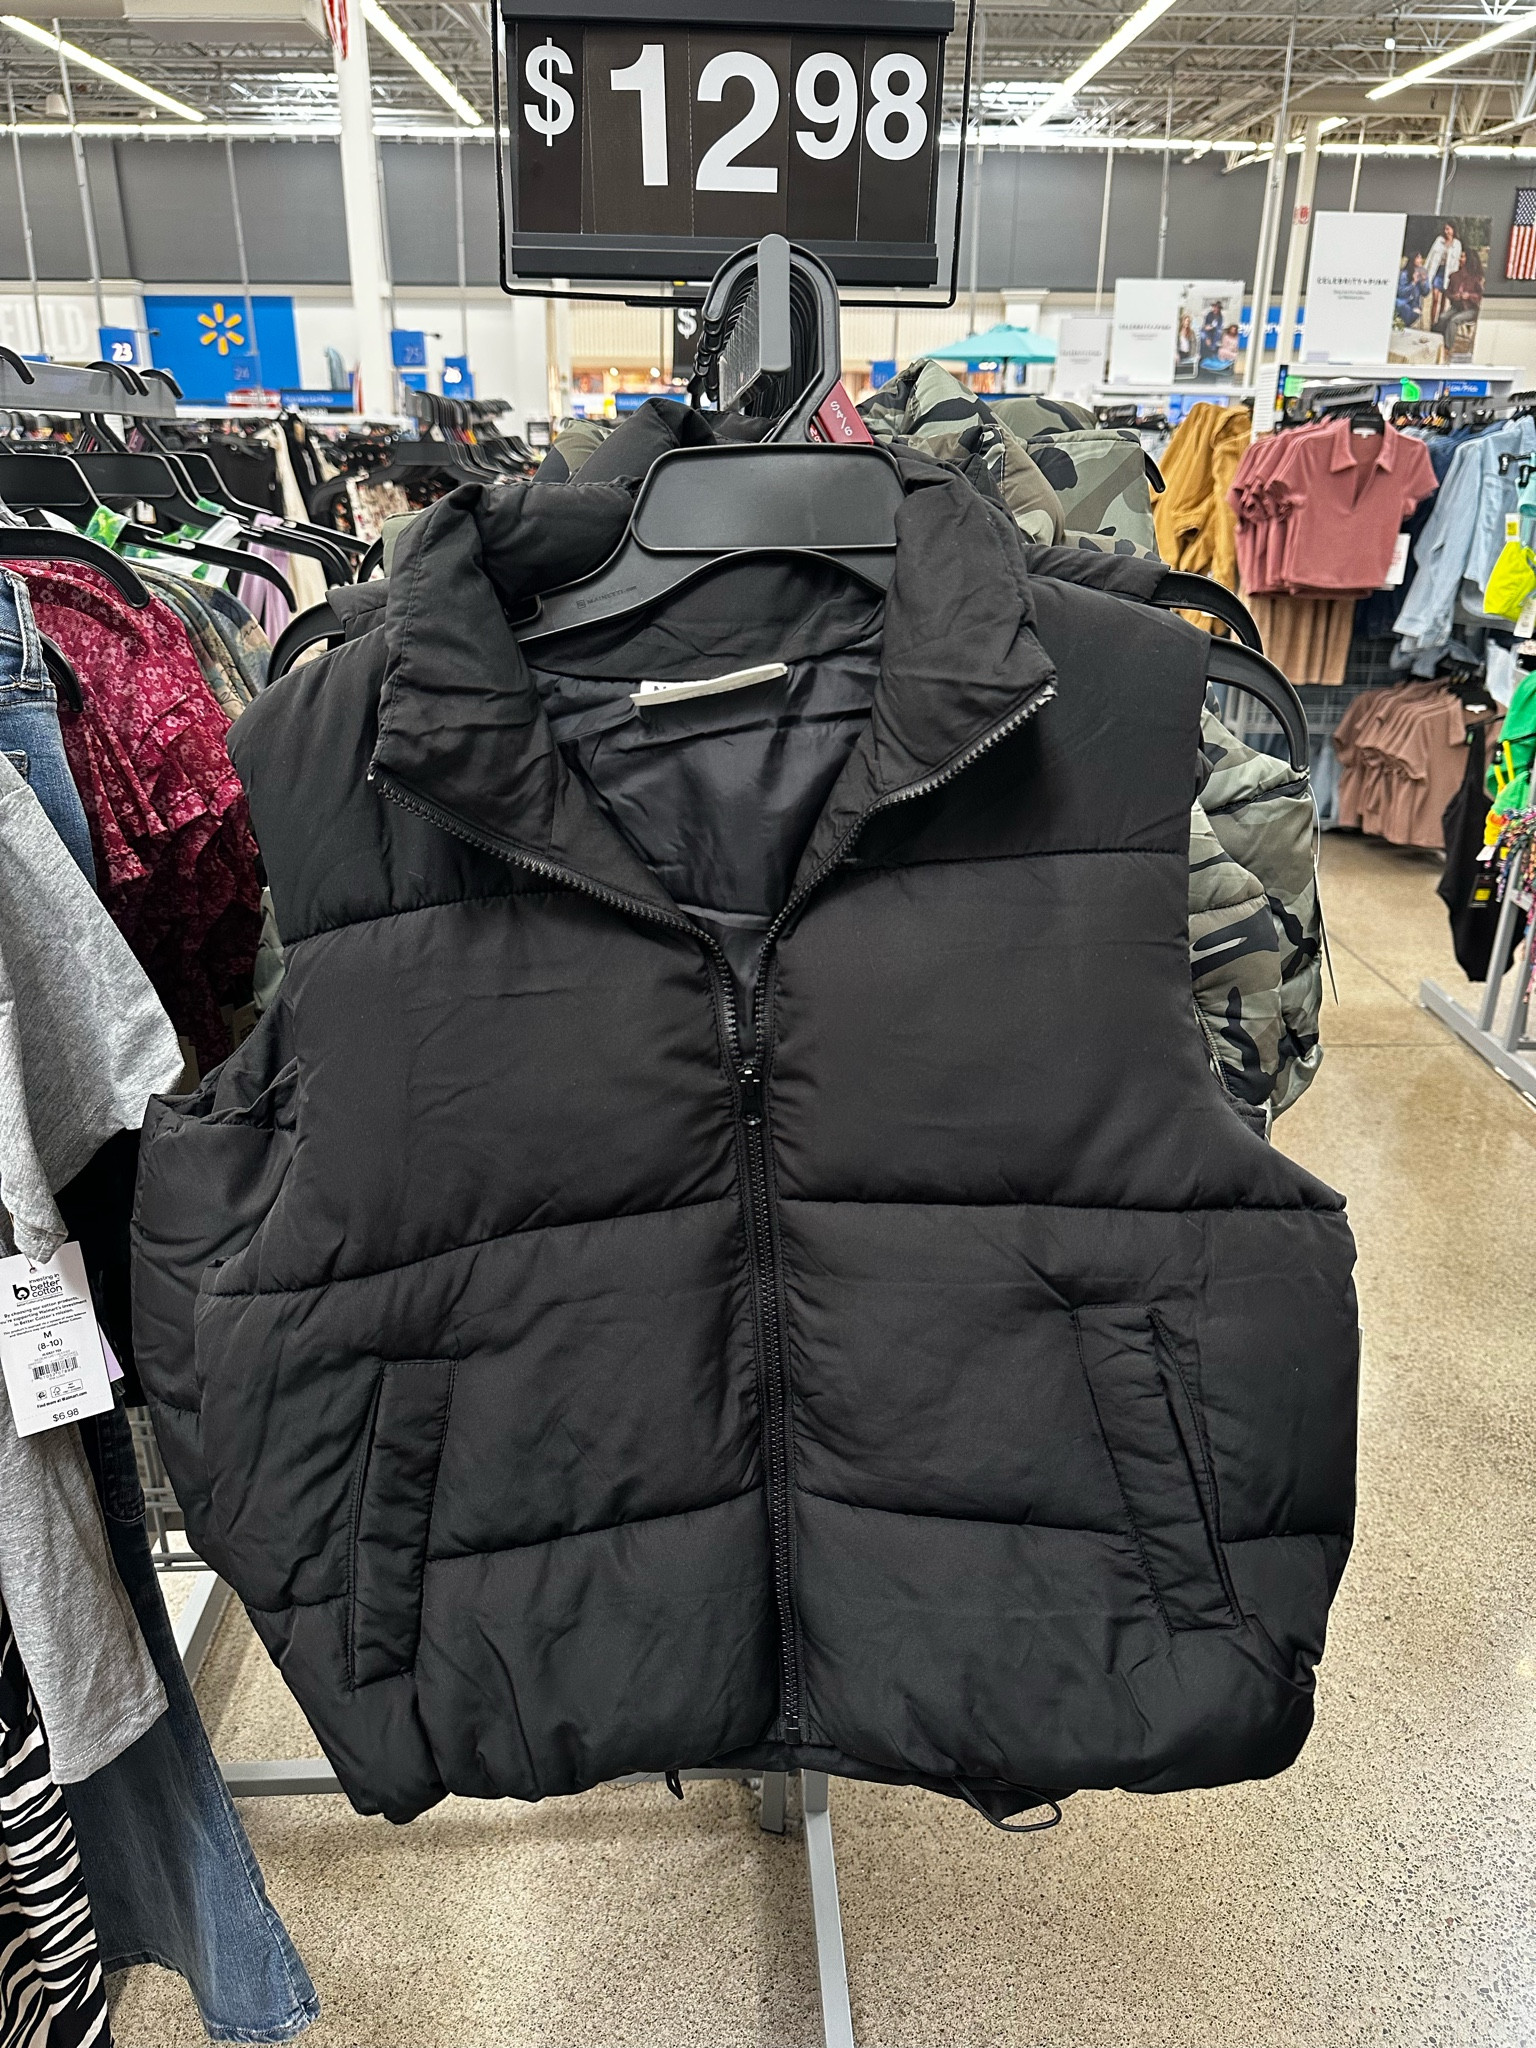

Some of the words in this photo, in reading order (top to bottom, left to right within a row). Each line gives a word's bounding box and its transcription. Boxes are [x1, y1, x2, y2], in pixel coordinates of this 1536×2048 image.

[111, 342, 133, 362] 23
[30, 1279, 60, 1291] better
[32, 1285, 63, 1298] cotton
[43, 1330, 52, 1339] M
[37, 1337, 63, 1352] (8-10)
[52, 1407, 79, 1422] $6.98
